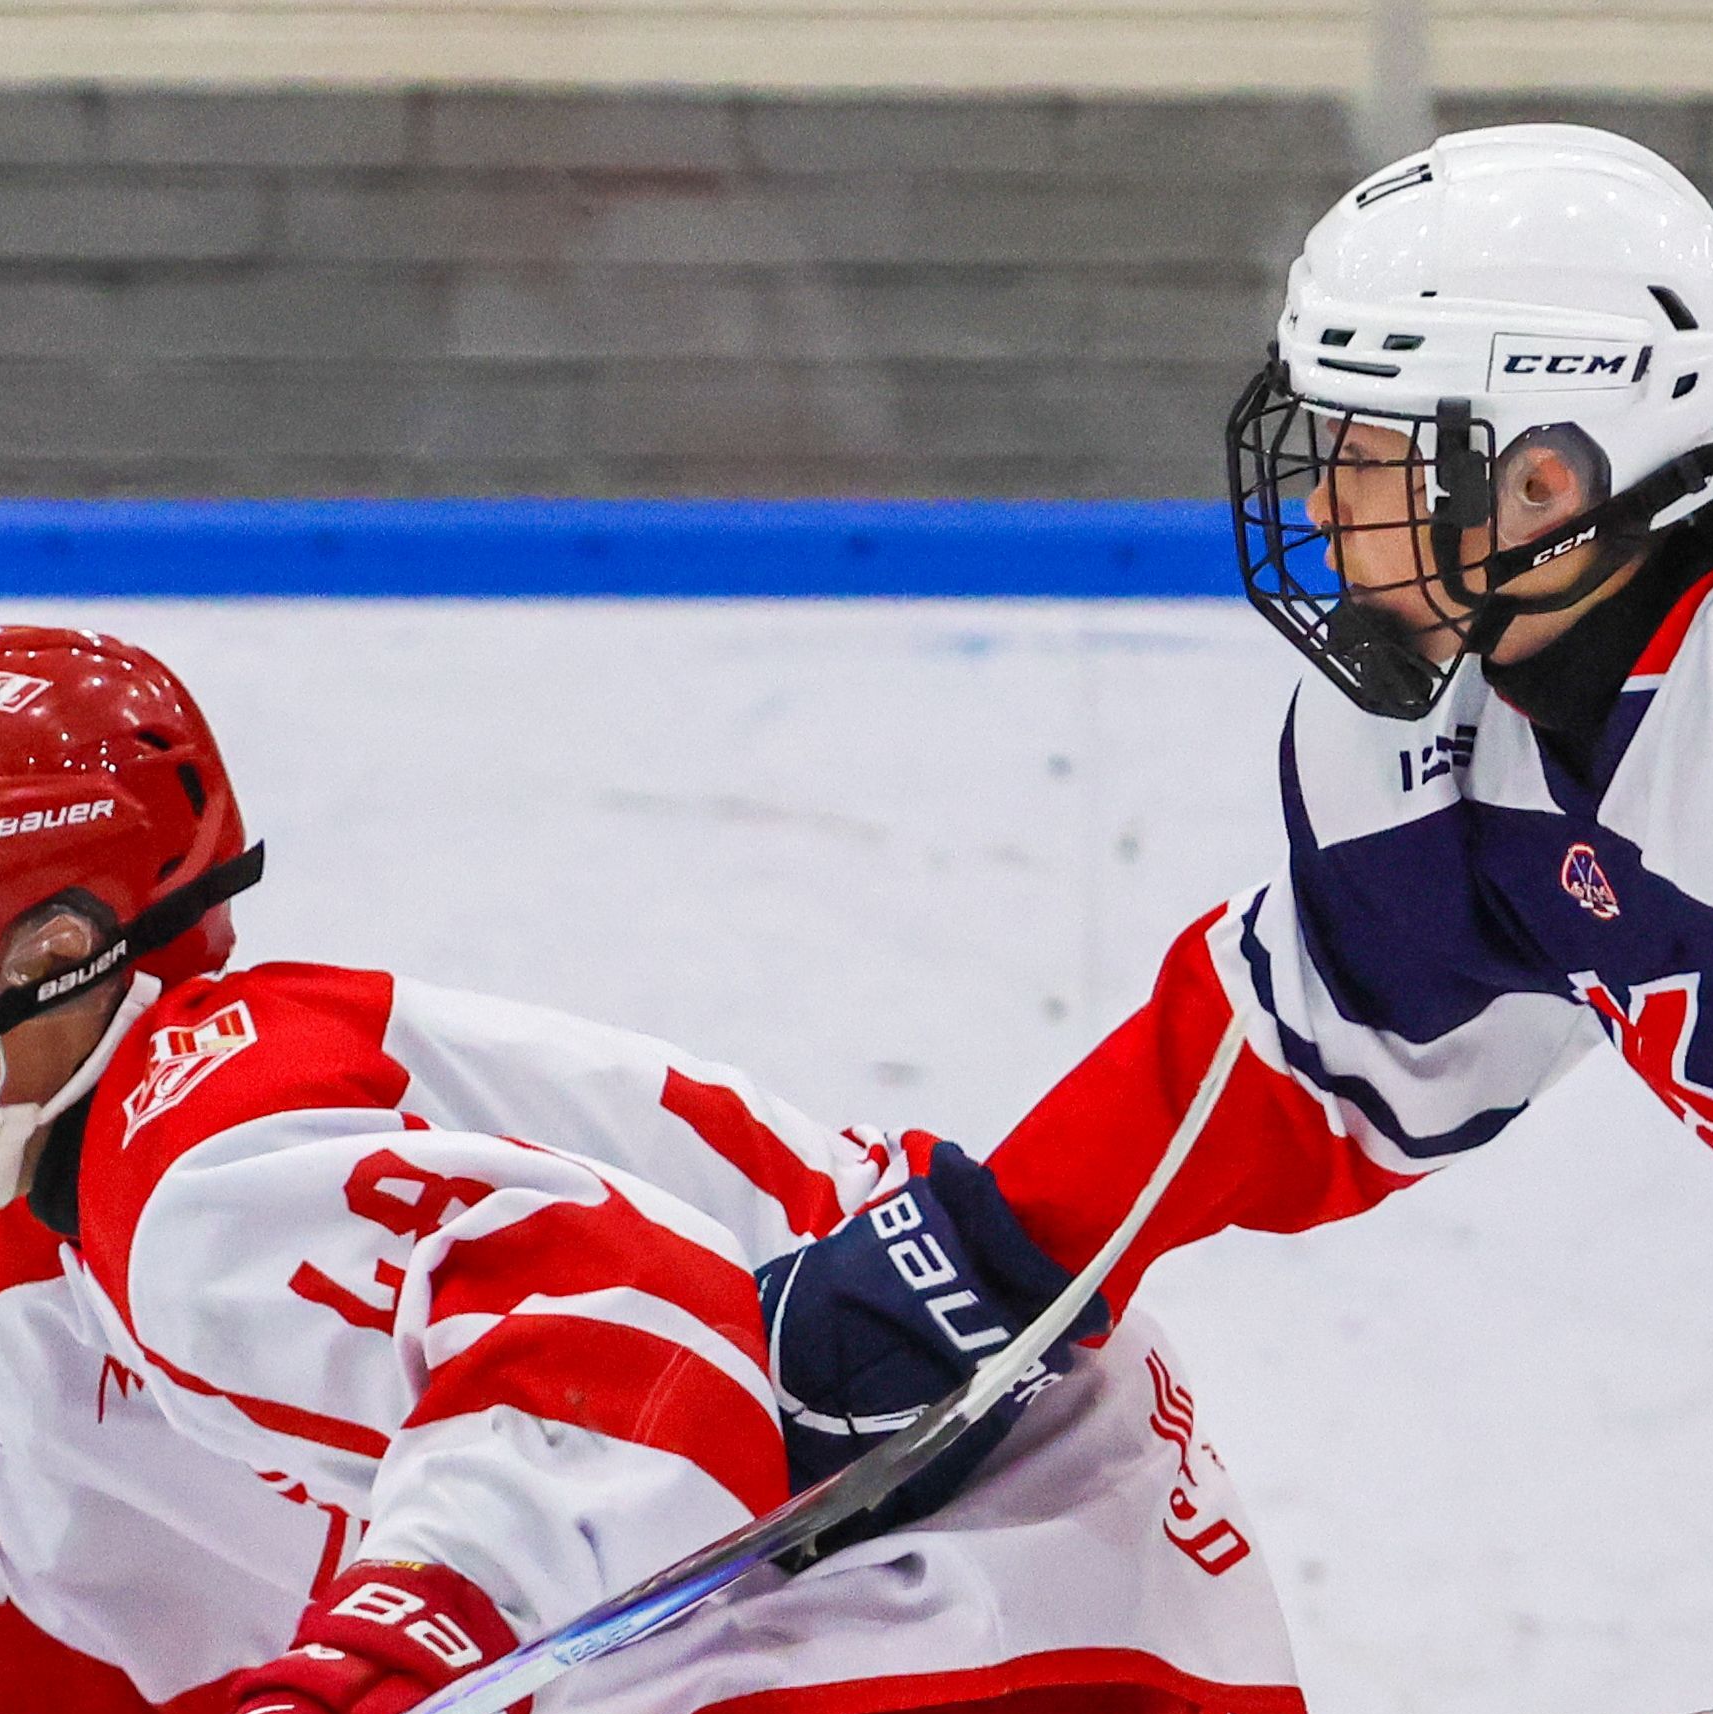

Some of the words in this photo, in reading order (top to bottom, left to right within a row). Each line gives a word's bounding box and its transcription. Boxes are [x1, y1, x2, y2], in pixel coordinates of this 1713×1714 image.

[1504, 354, 1627, 374] CCM
[1532, 525, 1597, 567] CCM
[37, 939, 128, 1002] BAUER
